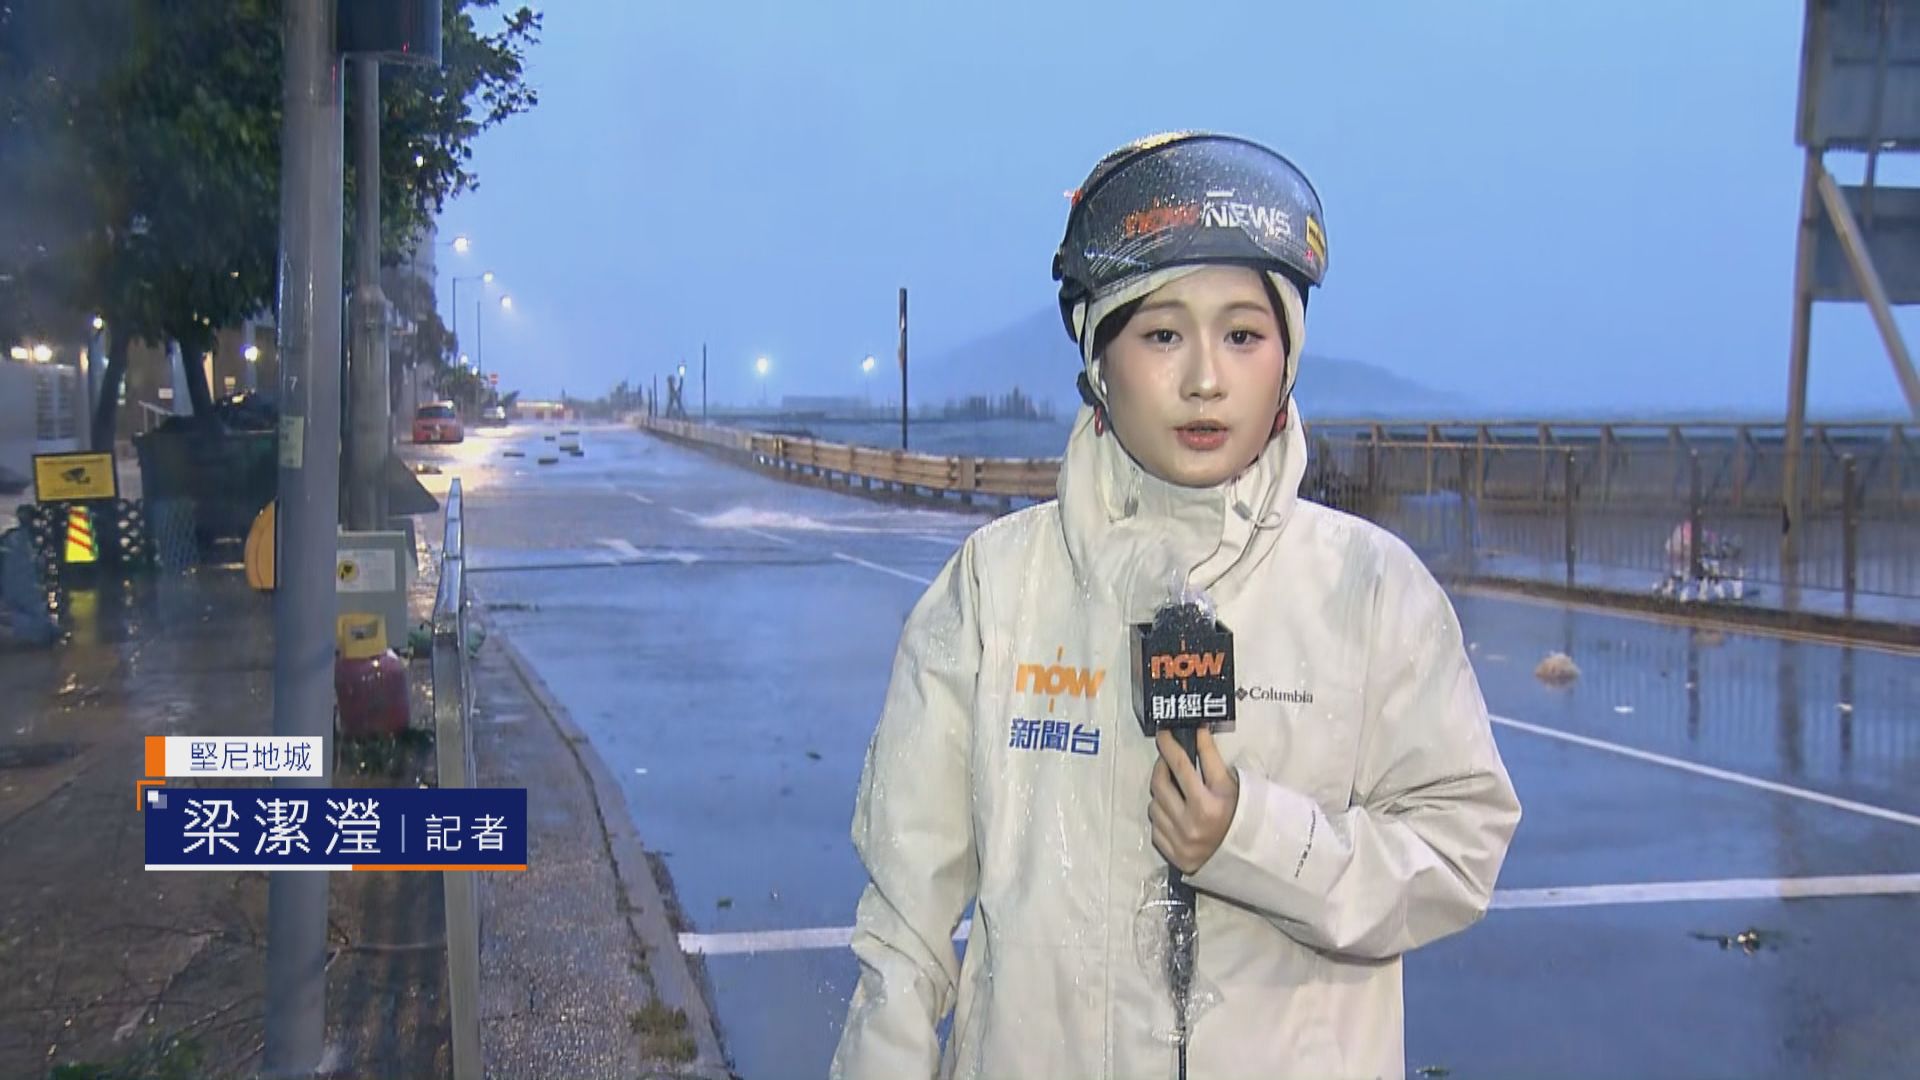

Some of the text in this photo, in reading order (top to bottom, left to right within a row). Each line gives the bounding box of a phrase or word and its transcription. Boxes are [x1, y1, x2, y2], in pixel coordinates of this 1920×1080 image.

[1201, 201, 1292, 236] NEWS
[1015, 661, 1106, 698] now
[1151, 650, 1225, 680] now
[1152, 692, 1227, 721] 財經台
[1249, 686, 1313, 704] Columbia
[1009, 716, 1100, 756] 新聞台
